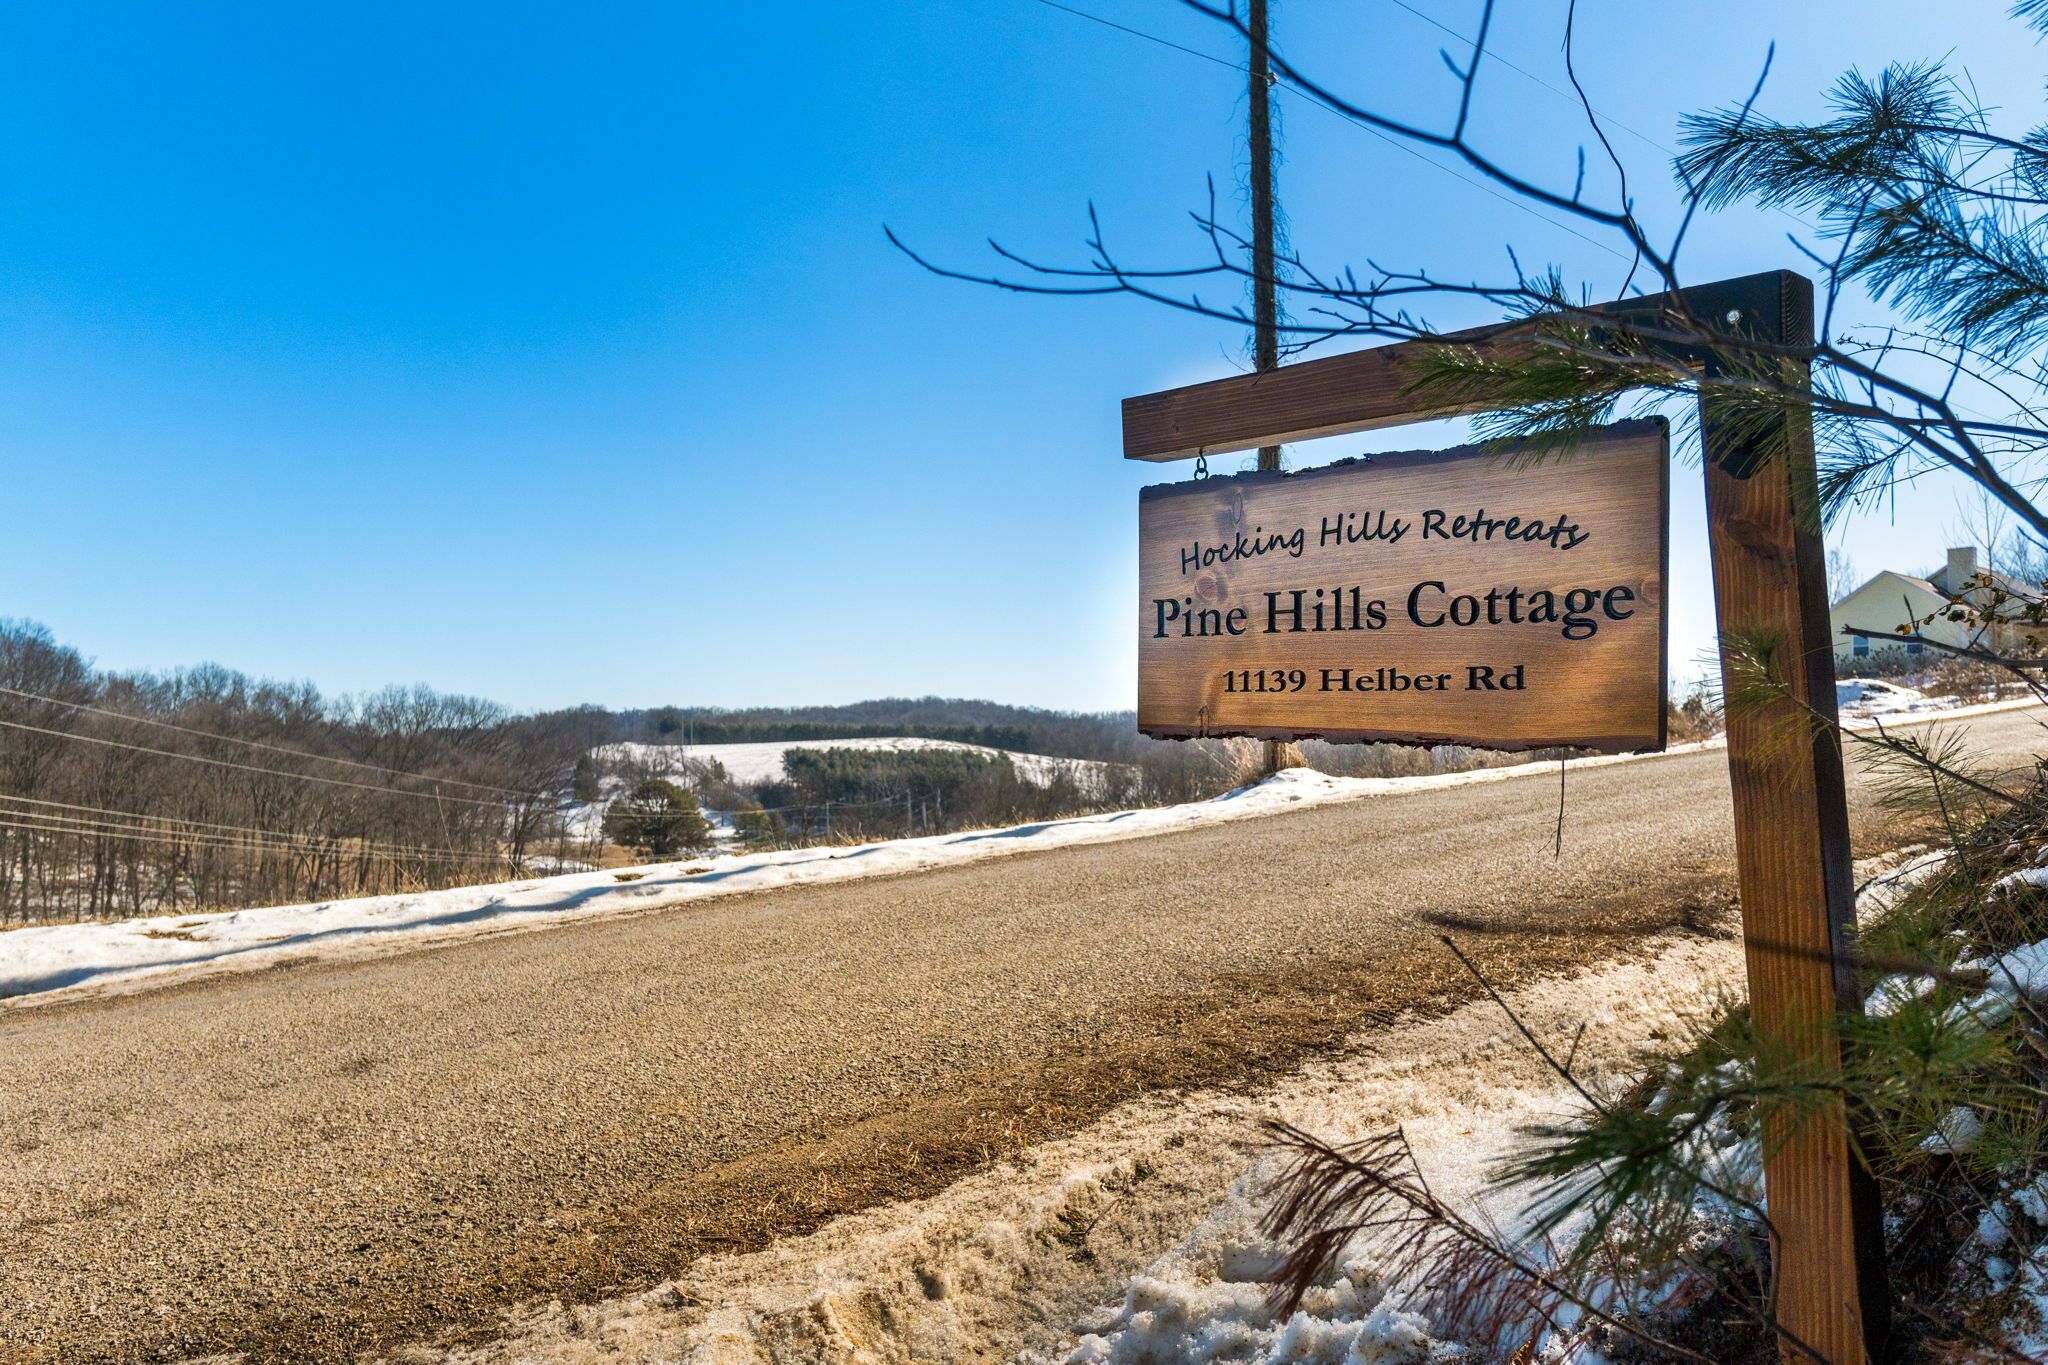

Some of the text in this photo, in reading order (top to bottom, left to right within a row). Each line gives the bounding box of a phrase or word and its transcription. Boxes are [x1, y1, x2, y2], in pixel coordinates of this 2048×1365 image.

[1180, 508, 1590, 575] Hocking Hills Retreats
[1152, 580, 1636, 641] Pine Hills Cottage
[1222, 664, 1527, 694] 11139 Helber Rd
